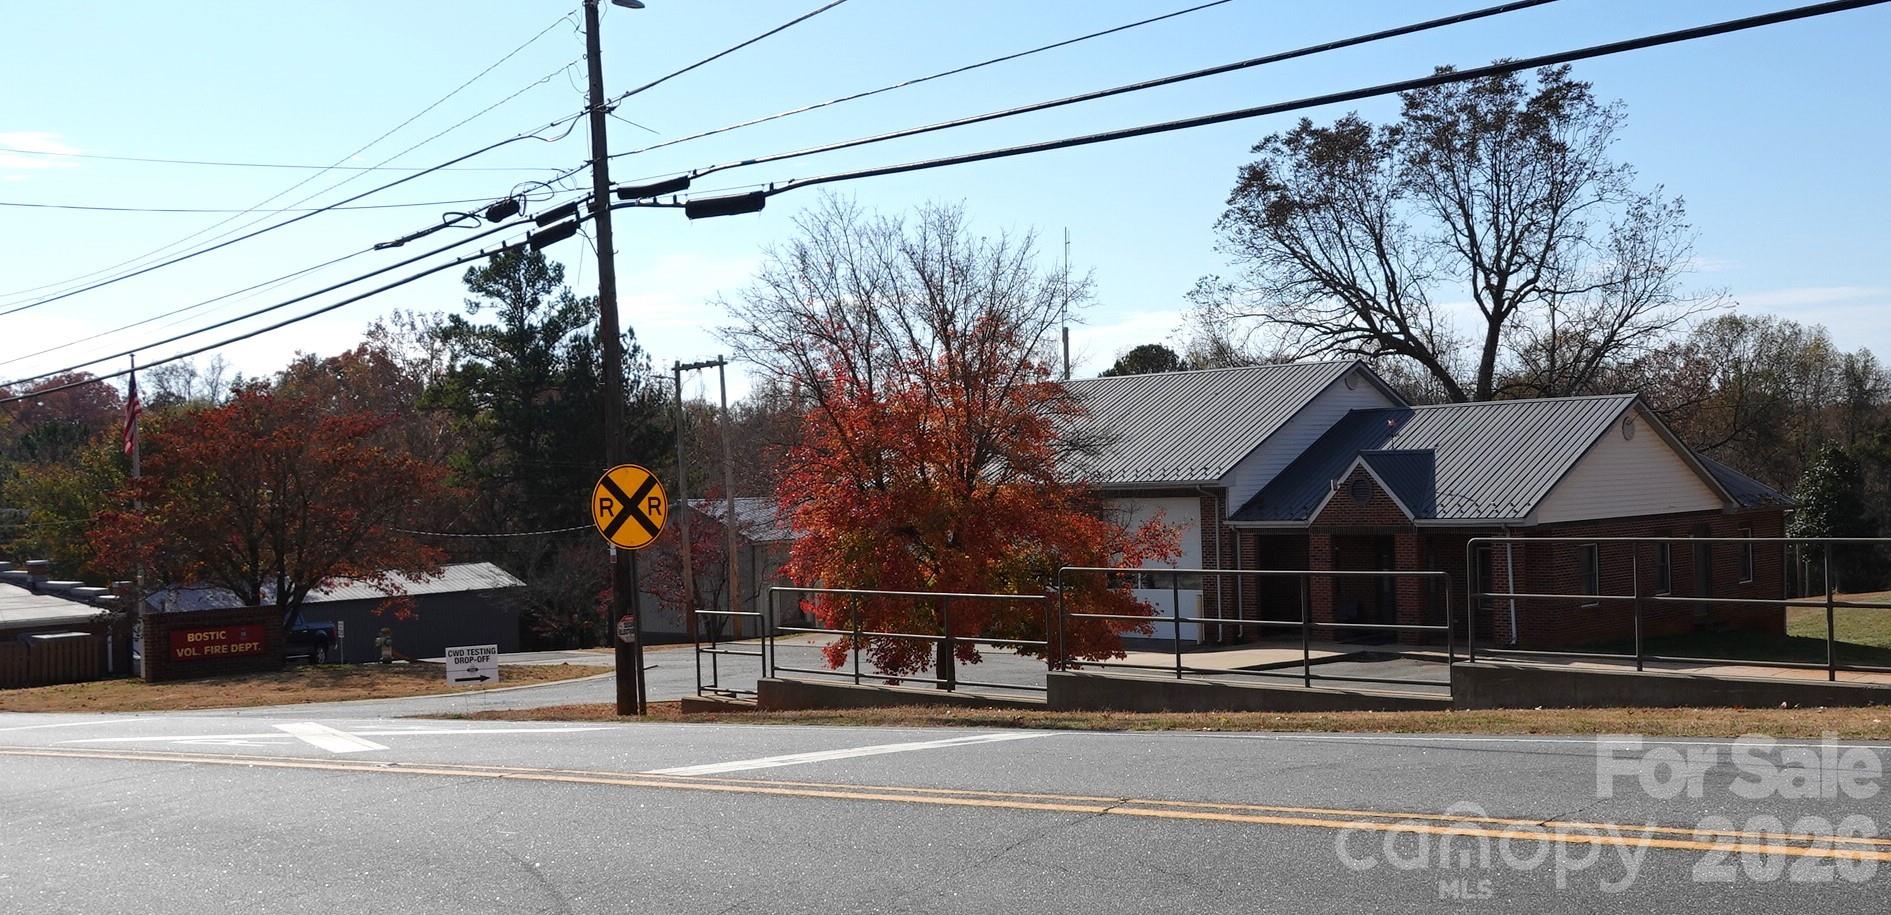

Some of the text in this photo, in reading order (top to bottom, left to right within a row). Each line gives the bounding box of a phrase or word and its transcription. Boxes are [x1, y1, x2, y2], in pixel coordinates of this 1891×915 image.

[599, 496, 662, 517] R R
[187, 631, 227, 642] BOSTIC
[204, 644, 229, 655] FIRE
[230, 642, 261, 653] DEPT.
[467, 647, 496, 656] TESTING
[454, 656, 490, 664] DROP-OFF
